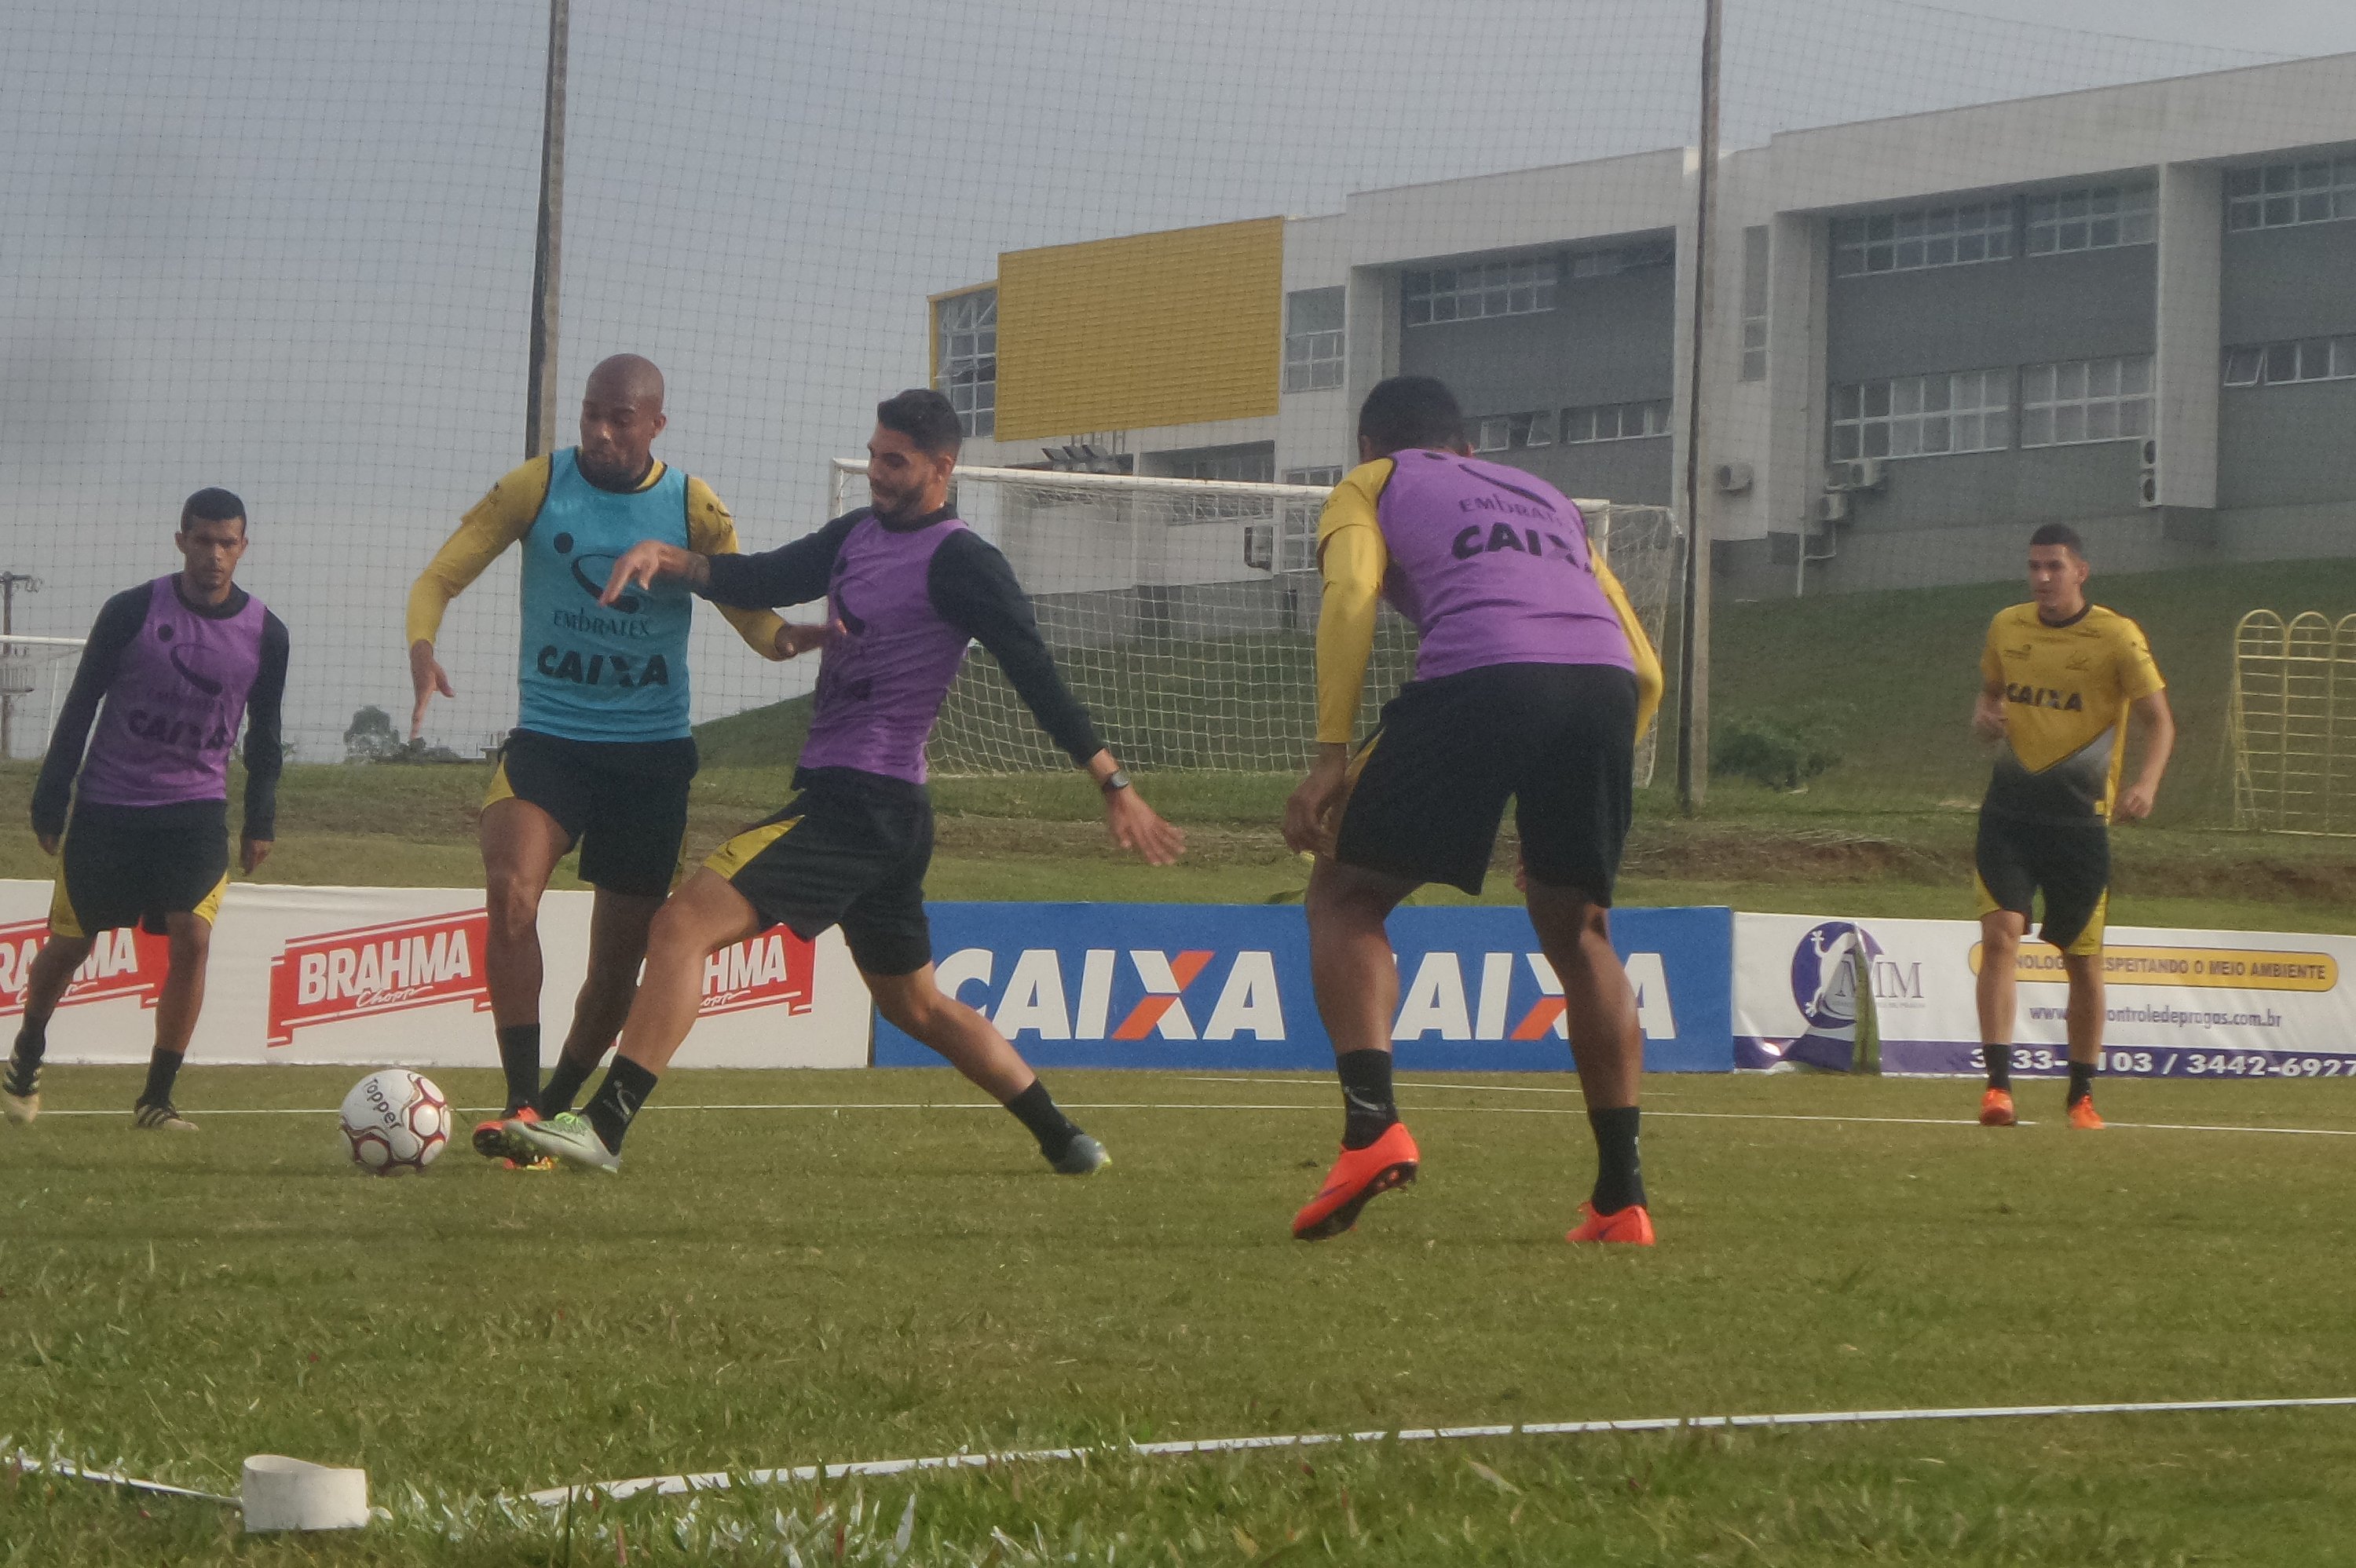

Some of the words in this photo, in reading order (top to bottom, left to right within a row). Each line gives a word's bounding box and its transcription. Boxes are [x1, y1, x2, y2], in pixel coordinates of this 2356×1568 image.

[538, 645, 668, 687] CAIXA
[2006, 682, 2083, 711] CAIXA
[0, 927, 138, 992] RAMA
[298, 929, 471, 1005] BRAHMA
[702, 934, 787, 995] HMA
[2103, 957, 2189, 974] SPEITANDO
[2194, 959, 2204, 974] O
[2209, 960, 2245, 977] MEIO
[2251, 962, 2325, 980] AMBIENTE
[934, 948, 1286, 1040] CAIXA
[1390, 952, 1675, 1040] AIXA
[1970, 1048, 2153, 1073] 333-103
[2186, 1054, 2356, 1077] 3442-6927
[364, 1078, 404, 1129] Topper
